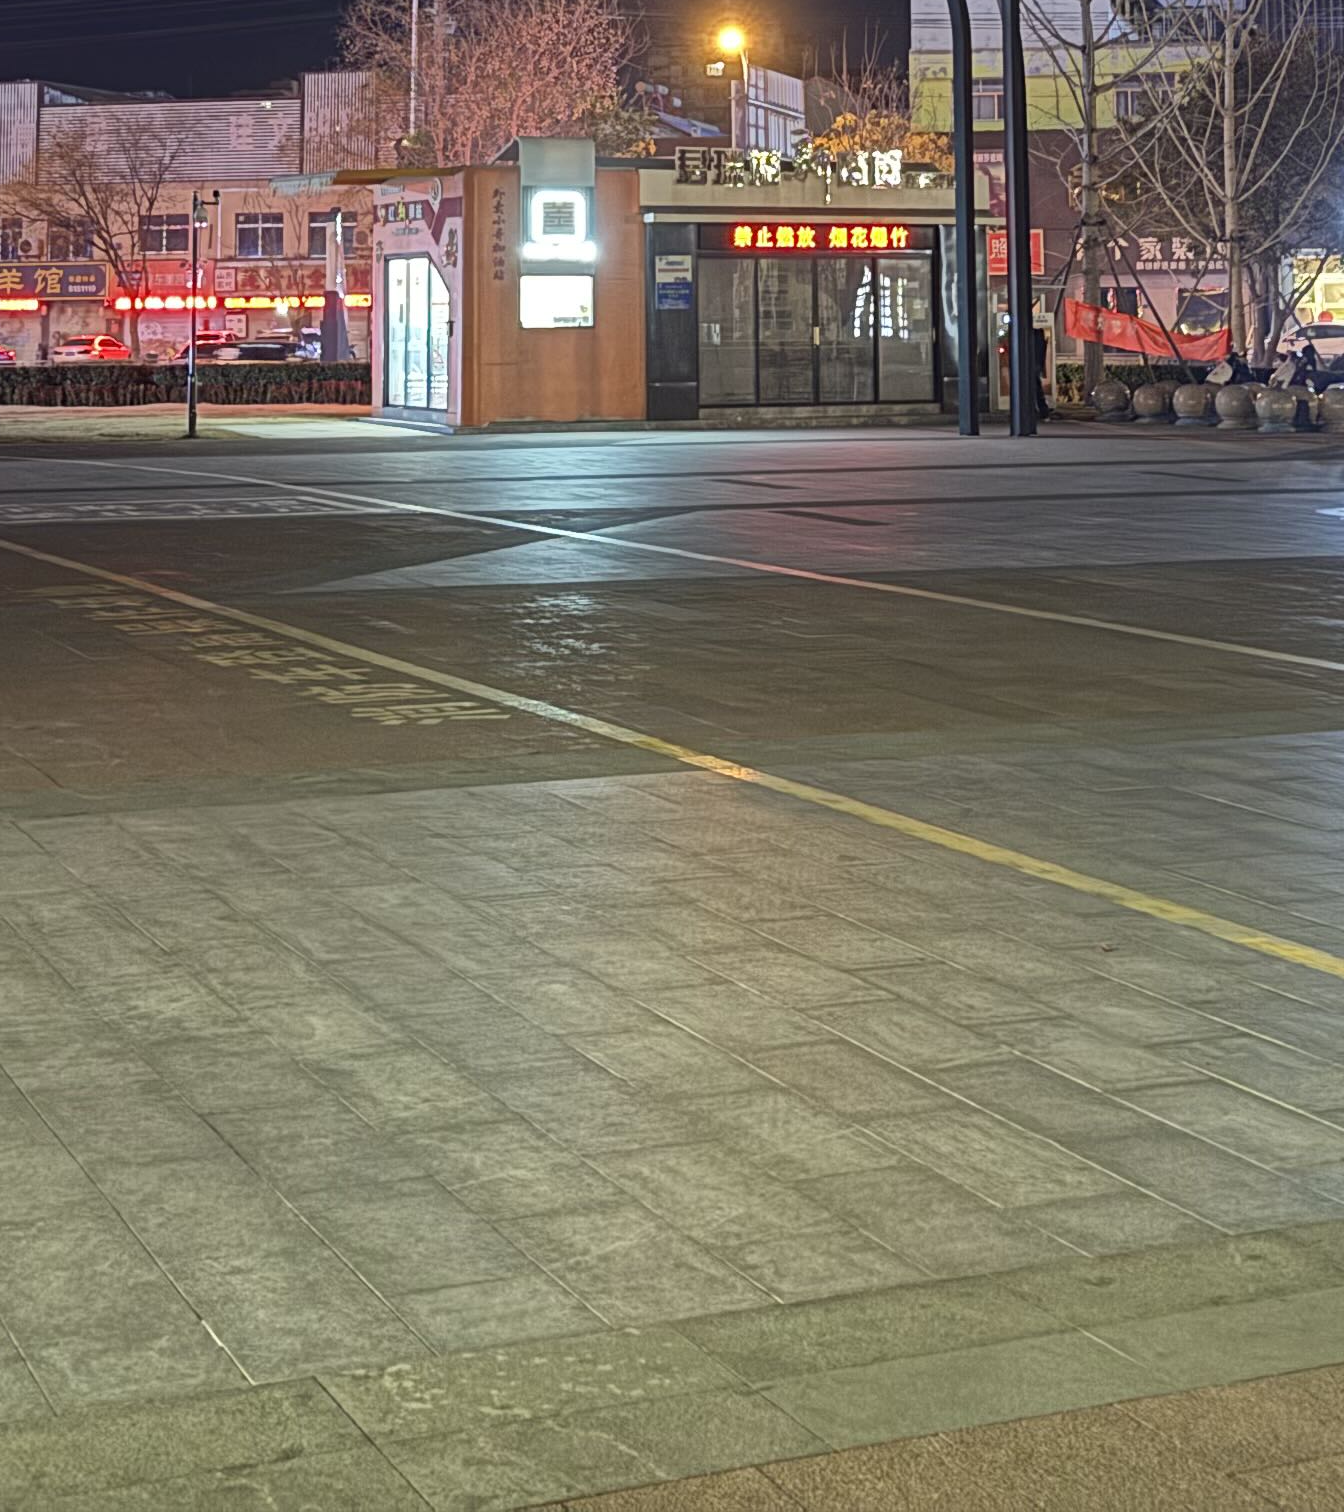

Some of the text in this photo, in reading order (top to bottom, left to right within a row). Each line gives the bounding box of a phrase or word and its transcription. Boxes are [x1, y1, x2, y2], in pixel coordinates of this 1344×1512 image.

[733, 226, 909, 248] 禁止燃放 烟花爆竹
